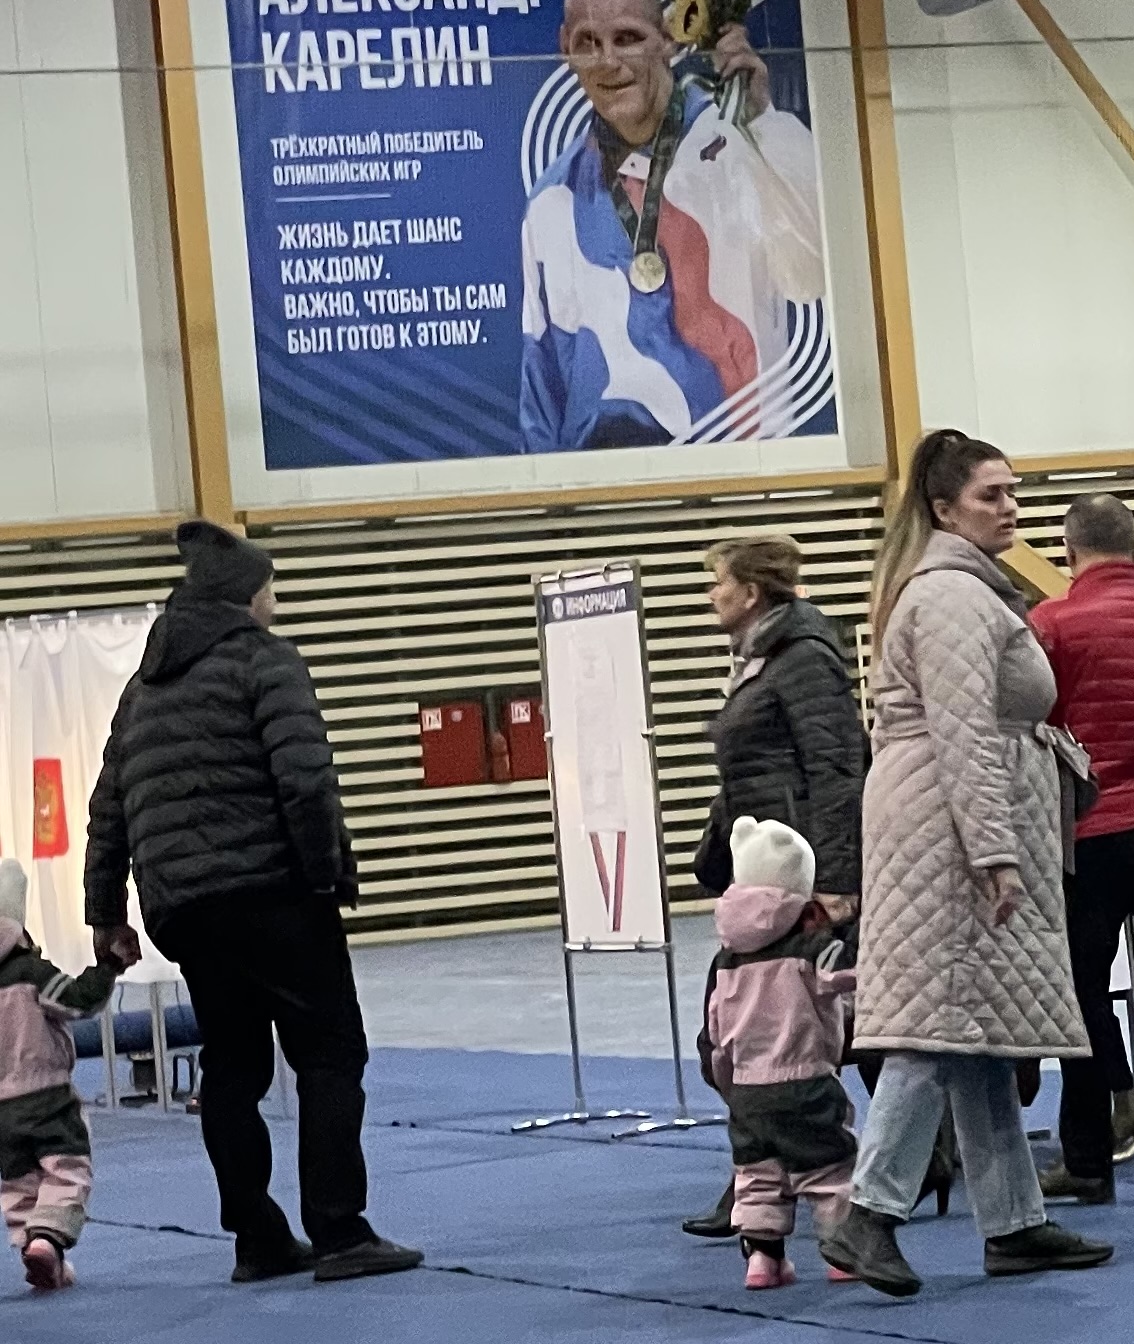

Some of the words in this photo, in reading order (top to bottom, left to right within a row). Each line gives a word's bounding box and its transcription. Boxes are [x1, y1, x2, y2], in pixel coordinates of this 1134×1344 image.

[261, 25, 493, 94] КАРЕЛИН
[270, 130, 381, 160] ТРЁХКРАТНЫЙ
[384, 129, 484, 154] ПОБЕДИТЕЛЬ
[273, 160, 391, 187] ОЛИМПИЙСКИХ
[393, 159, 422, 181] ИГР
[277, 221, 349, 250] ЖИЗНЬ
[352, 219, 401, 249] ДАЕТ
[406, 216, 463, 244] ШАНС
[280, 254, 391, 285] КАЖДОМУ.
[284, 291, 361, 320] ВАЖНО,
[363, 285, 429, 315] ЧТОБЫ
[432, 285, 462, 312] ТЫ
[465, 283, 506, 310] САМ
[287, 327, 333, 354] БЫЛ
[336, 323, 396, 352] ГОТОВ
[399, 322, 413, 349] К
[416, 319, 488, 347] ЭТОМУ.
[565, 588, 627, 616] ИНФОРМАЦИЯ
